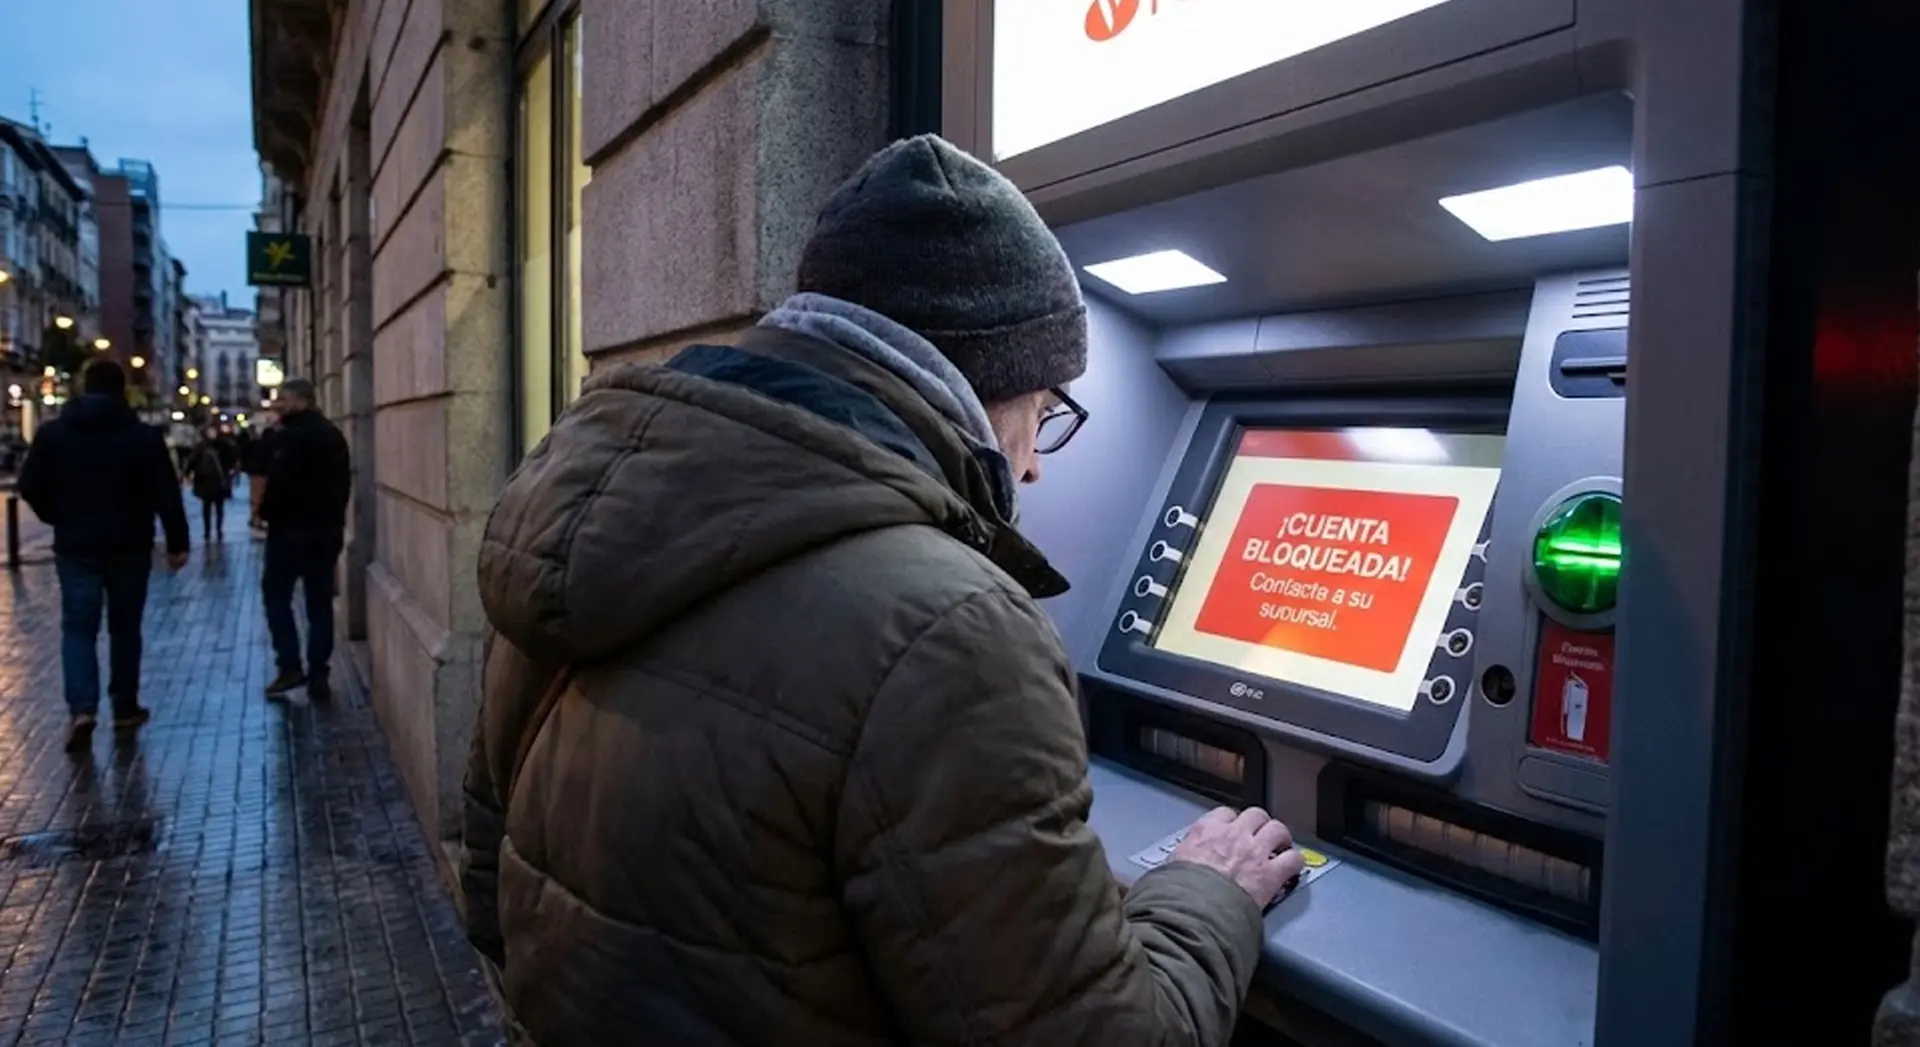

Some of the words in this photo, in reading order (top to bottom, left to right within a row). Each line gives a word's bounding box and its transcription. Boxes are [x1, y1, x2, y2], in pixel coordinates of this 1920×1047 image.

[1277, 512, 1390, 545] ¡CUENTA
[1242, 538, 1412, 582] BLOQUEADA!
[1331, 588, 1345, 605] a
[1348, 591, 1374, 609] su
[1259, 602, 1338, 630] sucursal.
